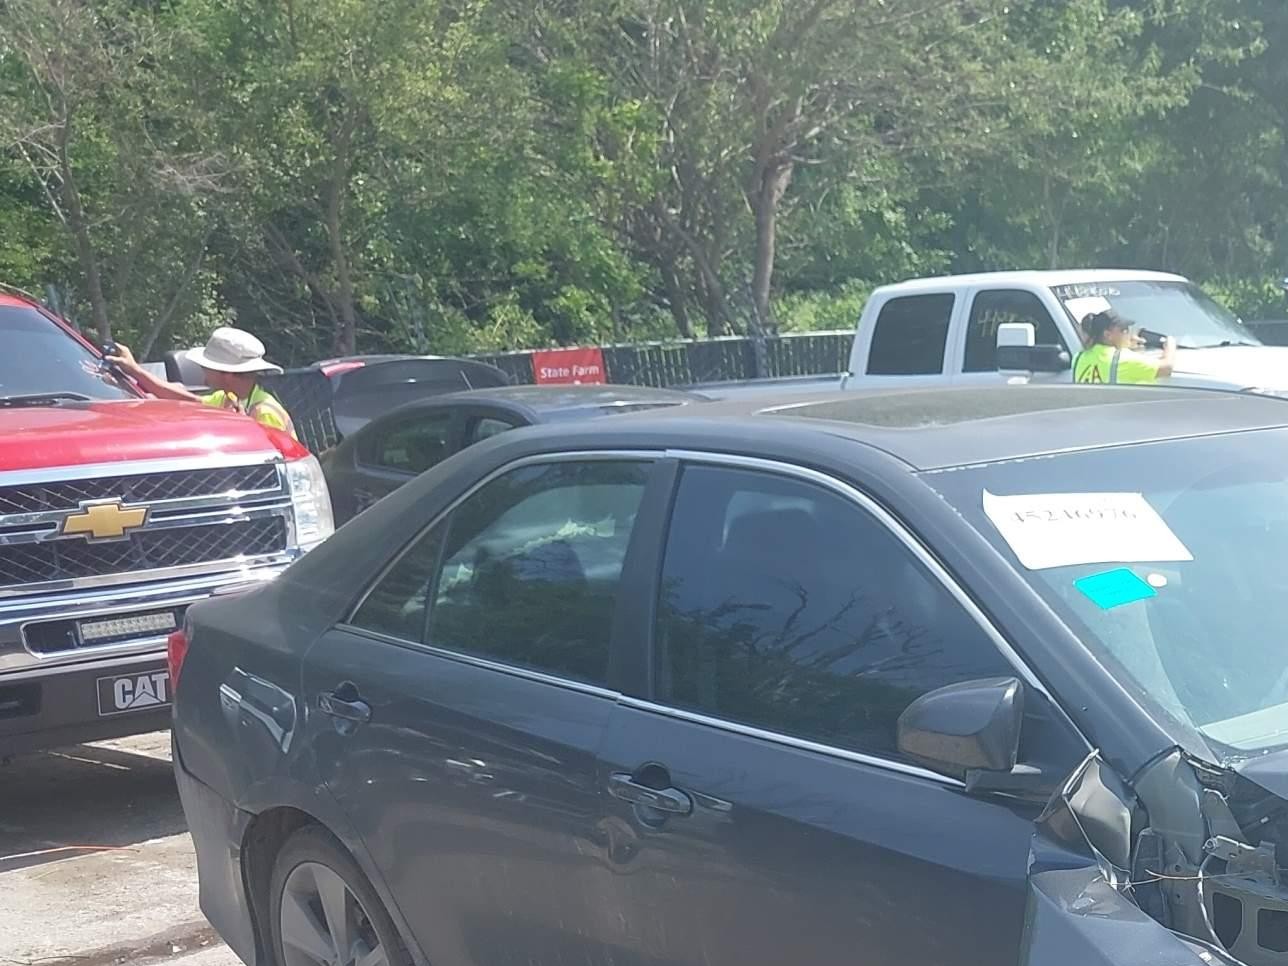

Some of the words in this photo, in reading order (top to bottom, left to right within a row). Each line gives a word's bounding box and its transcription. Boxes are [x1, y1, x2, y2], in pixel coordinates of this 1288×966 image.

[540, 367, 570, 379] State
[572, 364, 600, 377] Farm
[113, 672, 170, 710] CAT
